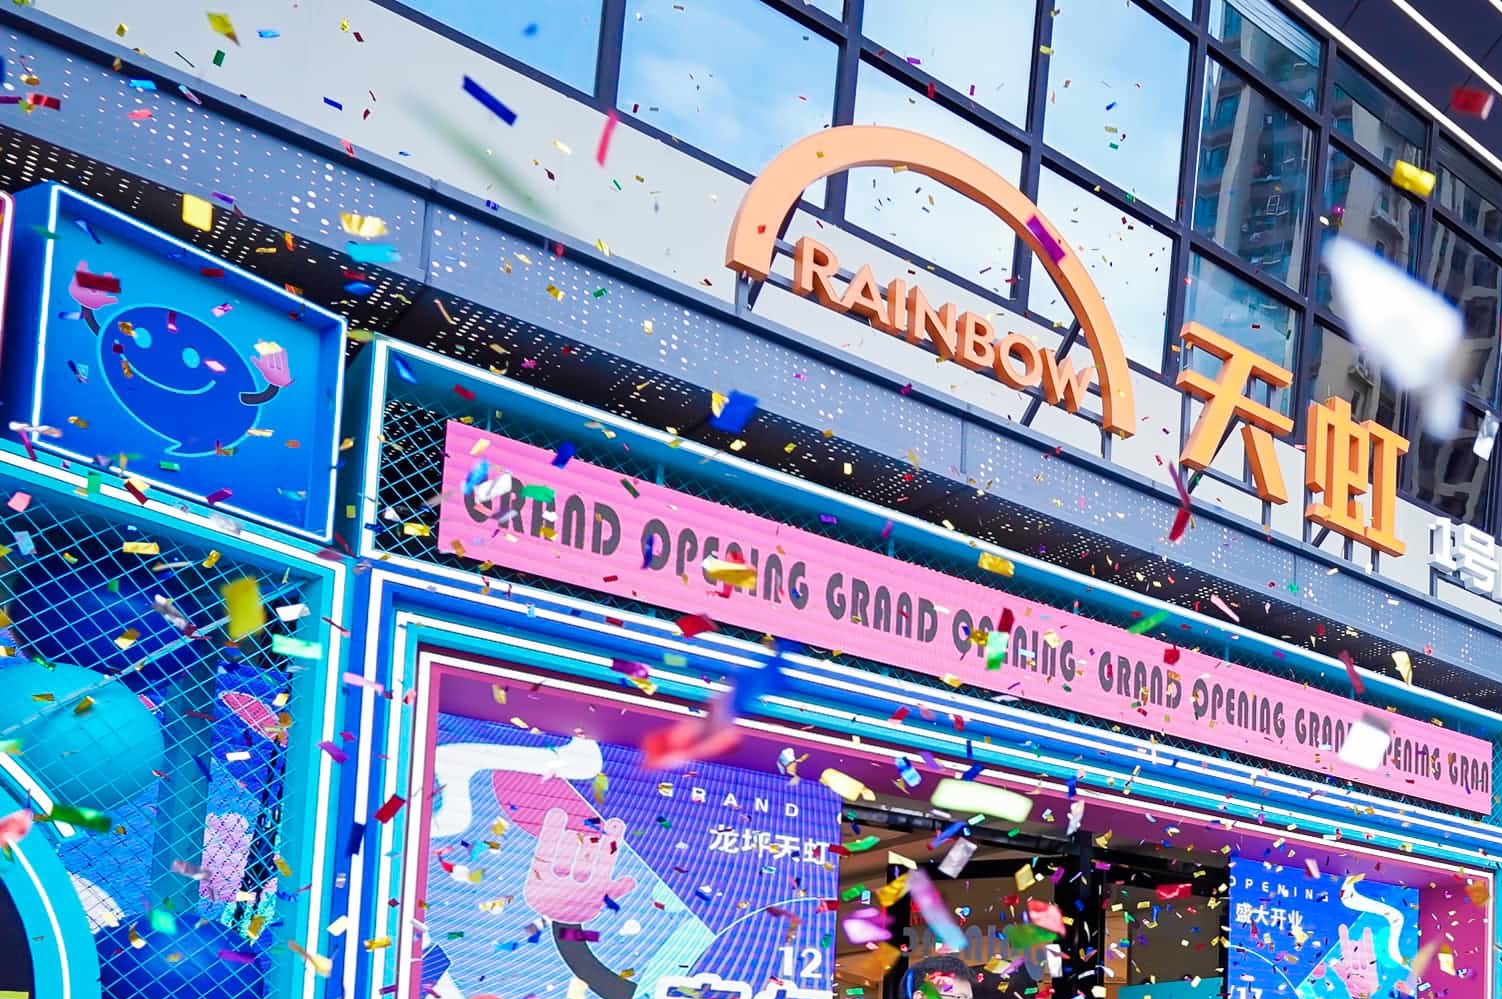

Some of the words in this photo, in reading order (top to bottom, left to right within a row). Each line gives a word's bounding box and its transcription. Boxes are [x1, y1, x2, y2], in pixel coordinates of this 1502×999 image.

[795, 236, 1092, 413] RAINBOW
[1177, 321, 1410, 558] 天虹
[826, 572, 938, 643] GRAND
[952, 609, 1076, 682] OPNING
[1099, 651, 1182, 709] GRAND
[1192, 678, 1286, 738] OPENING
[1294, 707, 1354, 753] GRAN
[708, 823, 830, 866] 龙坪天虹
[779, 946, 823, 979] 12
[1235, 902, 1304, 931] 盛大开业
